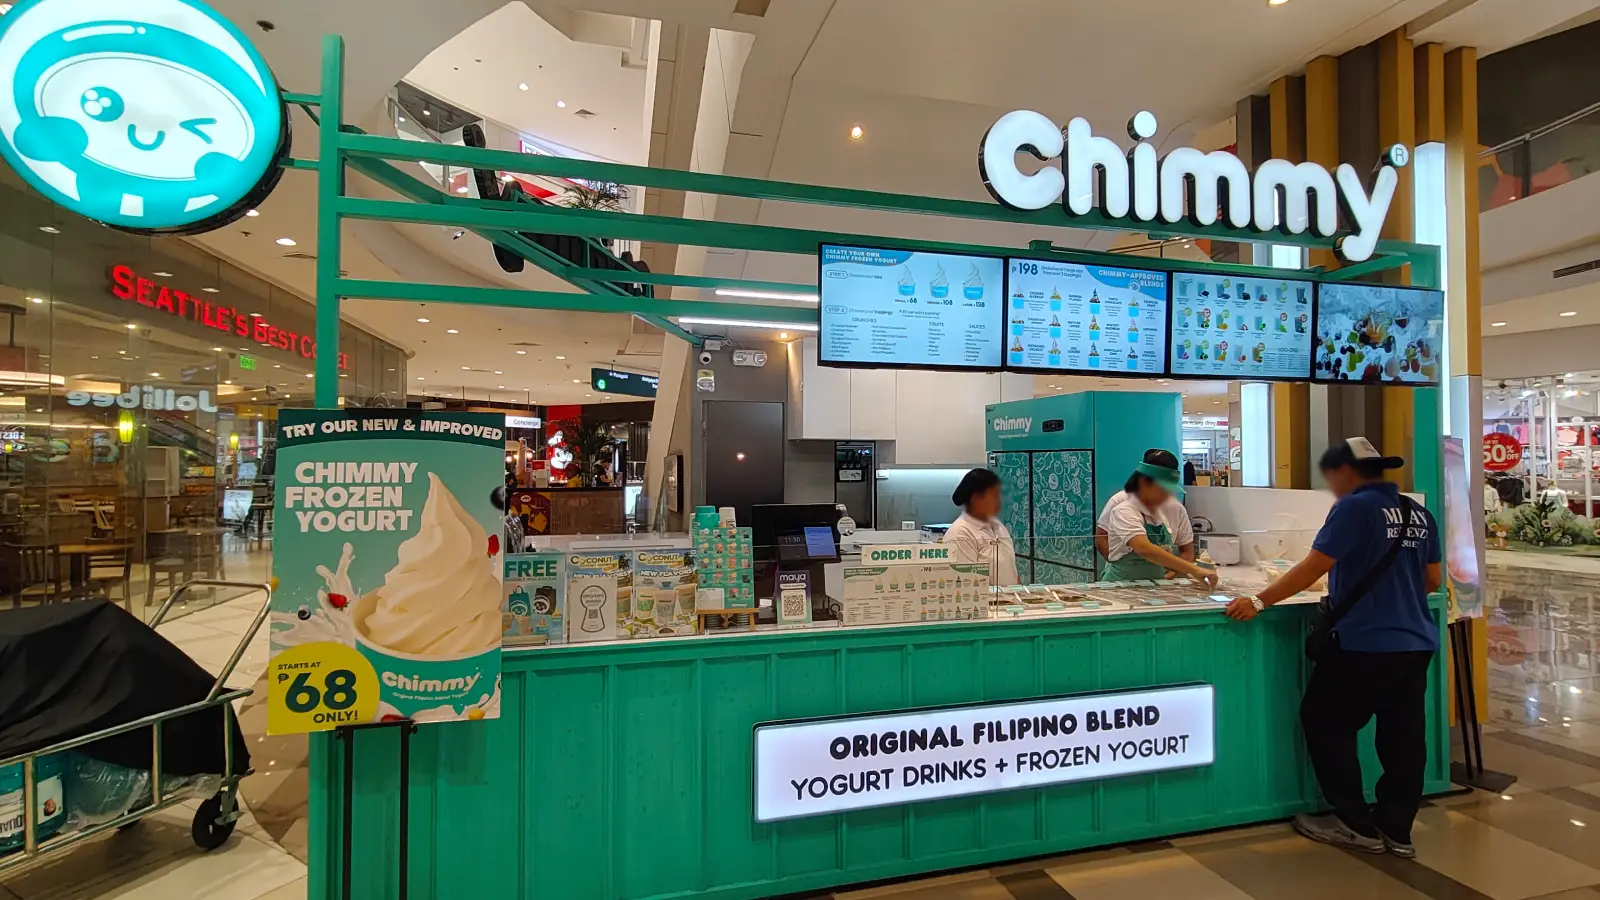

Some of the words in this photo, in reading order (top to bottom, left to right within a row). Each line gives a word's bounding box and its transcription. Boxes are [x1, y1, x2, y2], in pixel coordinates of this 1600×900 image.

[979, 110, 1399, 262] Chimmy
[1018, 263, 1038, 275] 198
[1140, 280, 1164, 288] BLENDS
[112, 264, 249, 336] SEATTLE'S
[254, 316, 298, 352] BEST
[282, 421, 316, 440] TRY
[321, 419, 358, 434] OUR
[362, 418, 398, 431] NEW
[403, 419, 416, 431] &
[420, 419, 502, 441] IMPROVED
[994, 416, 1032, 432] Chimmy
[295, 462, 418, 484] CHIMMY
[285, 486, 403, 508] FROZEN
[295, 509, 413, 533] YOGURT
[871, 549, 912, 562] ORDER
[920, 548, 948, 559] HERE
[505, 560, 557, 578] FREE
[780, 574, 806, 582] maya
[278, 662, 309, 670] STARTS
[381, 671, 480, 692] Chimmy
[313, 710, 358, 723] ONLY!
[830, 724, 963, 760] ORIGINAL
[974, 714, 1078, 745] FILIPINO
[1086, 704, 1160, 732] BLEND
[790, 768, 895, 800] YOGURT
[904, 758, 986, 787] DRINKS
[1016, 745, 1101, 773] FROZEN
[1107, 735, 1190, 762] YOGURT
